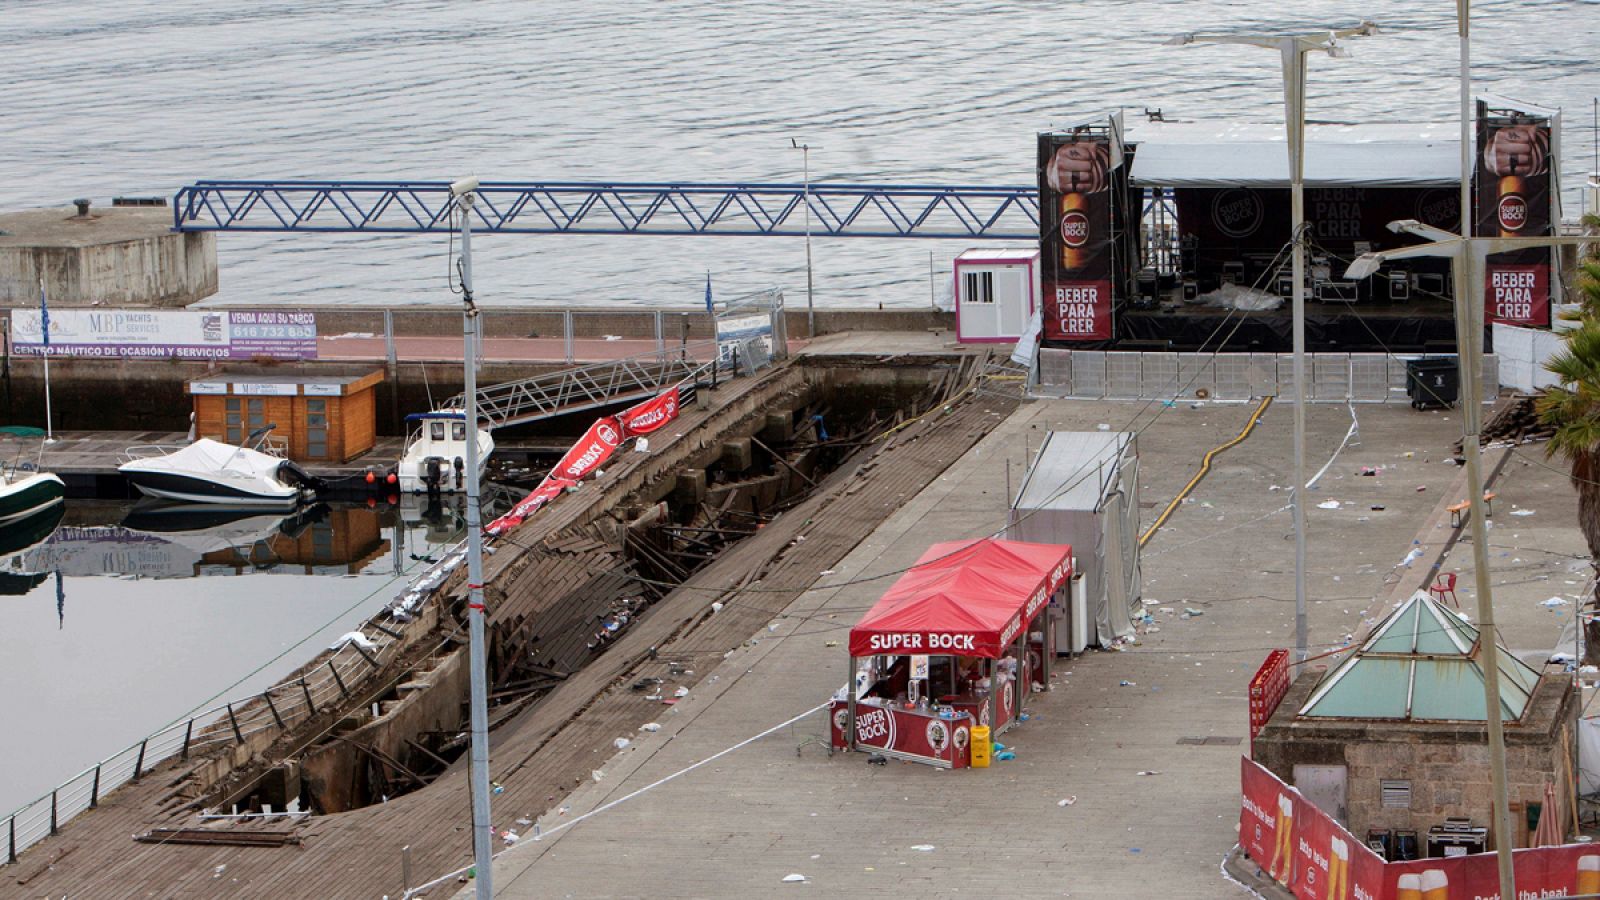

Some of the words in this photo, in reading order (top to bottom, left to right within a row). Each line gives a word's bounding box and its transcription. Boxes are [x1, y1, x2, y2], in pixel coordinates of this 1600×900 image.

[1316, 202, 1362, 219] PARA
[1502, 212, 1524, 220] BOCK
[1318, 220, 1360, 237] CRER
[1492, 272, 1535, 288] BEBER
[1056, 288, 1098, 303] BEBER
[1495, 288, 1532, 303] PARA
[125, 314, 152, 322] YACHTS
[231, 313, 256, 323] VENDA
[277, 313, 287, 323] SU
[1060, 304, 1095, 318] PARA
[1496, 303, 1532, 318] CRER
[89, 313, 124, 333] MBP
[126, 325, 160, 333] SERVICES
[1061, 318, 1094, 333] CRER
[261, 326, 285, 337] 732
[14, 345, 54, 355] CENTRO
[57, 344, 100, 356] NÁUTICO
[105, 346, 118, 356] DE
[120, 345, 164, 356] OCASIÓN
[167, 347, 175, 356] Y
[176, 347, 230, 357] SERVICIOS
[870, 633, 922, 649] SUPER
[928, 634, 975, 650] BOCK
[856, 709, 885, 729] SUPER
[859, 722, 888, 741] BOCK
[1541, 886, 1568, 897] beat
